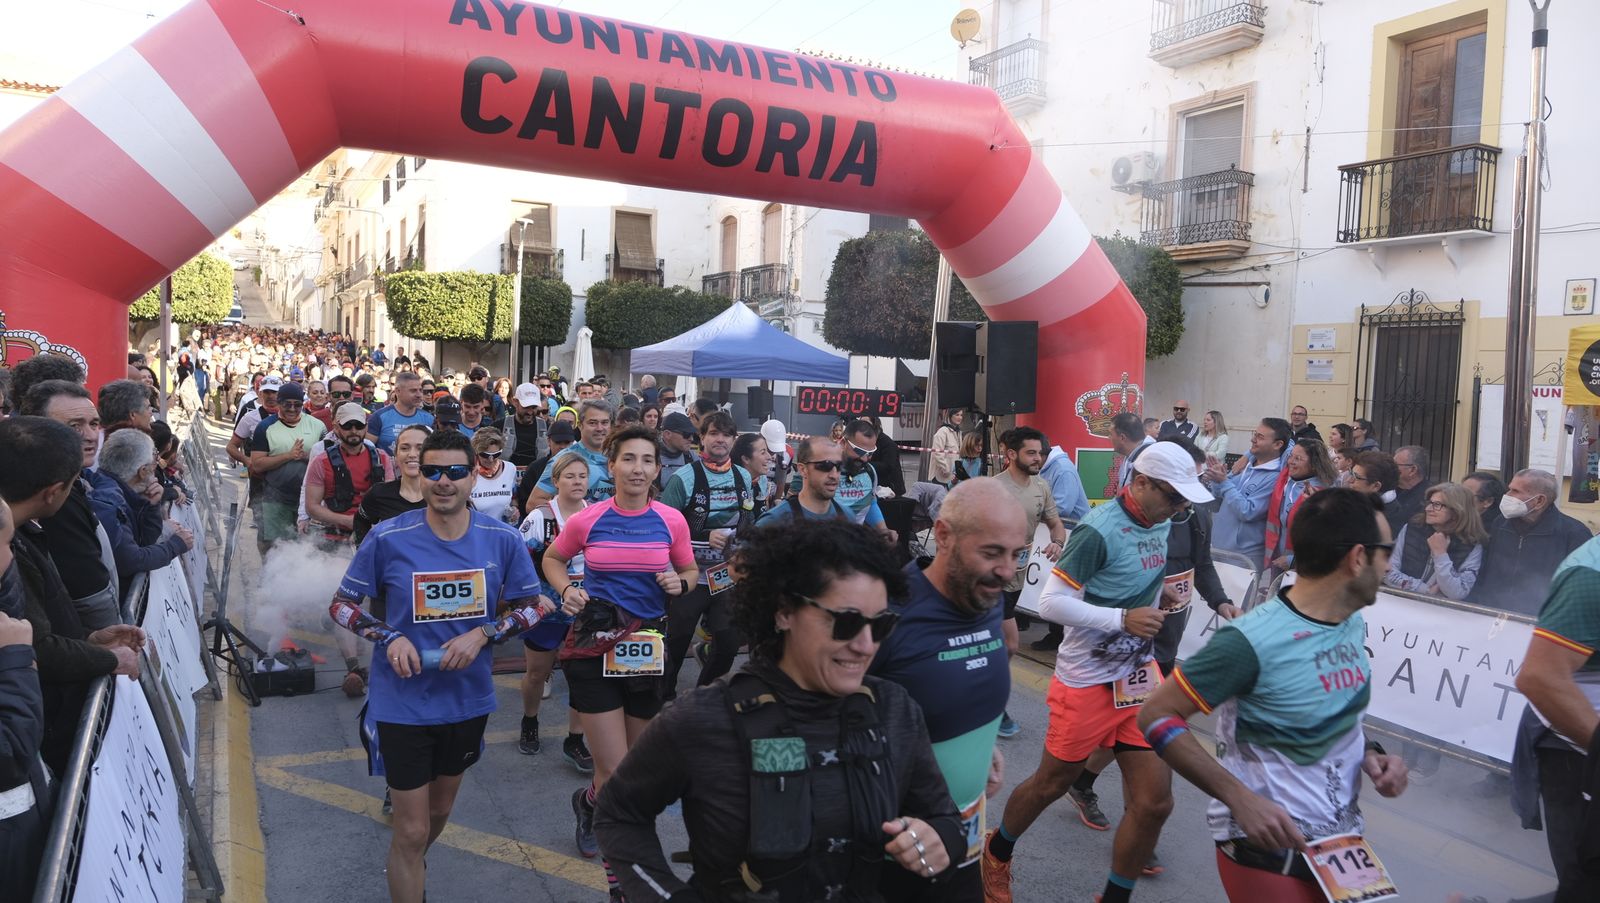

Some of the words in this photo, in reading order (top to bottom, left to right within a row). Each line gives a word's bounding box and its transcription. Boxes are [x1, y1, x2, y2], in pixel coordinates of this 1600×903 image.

[448, 0, 898, 102] AYUNTAMIENTO
[460, 55, 879, 187] CANTORIA
[800, 387, 899, 415] 00:00:19
[1137, 536, 1165, 554] PURA
[1140, 553, 1167, 571] VIDA
[426, 582, 472, 600] 305
[615, 643, 653, 657] 360
[1314, 641, 1360, 669] PURA
[1128, 669, 1148, 686] 22
[1319, 666, 1367, 693] VIDA
[1327, 847, 1376, 875] 112
